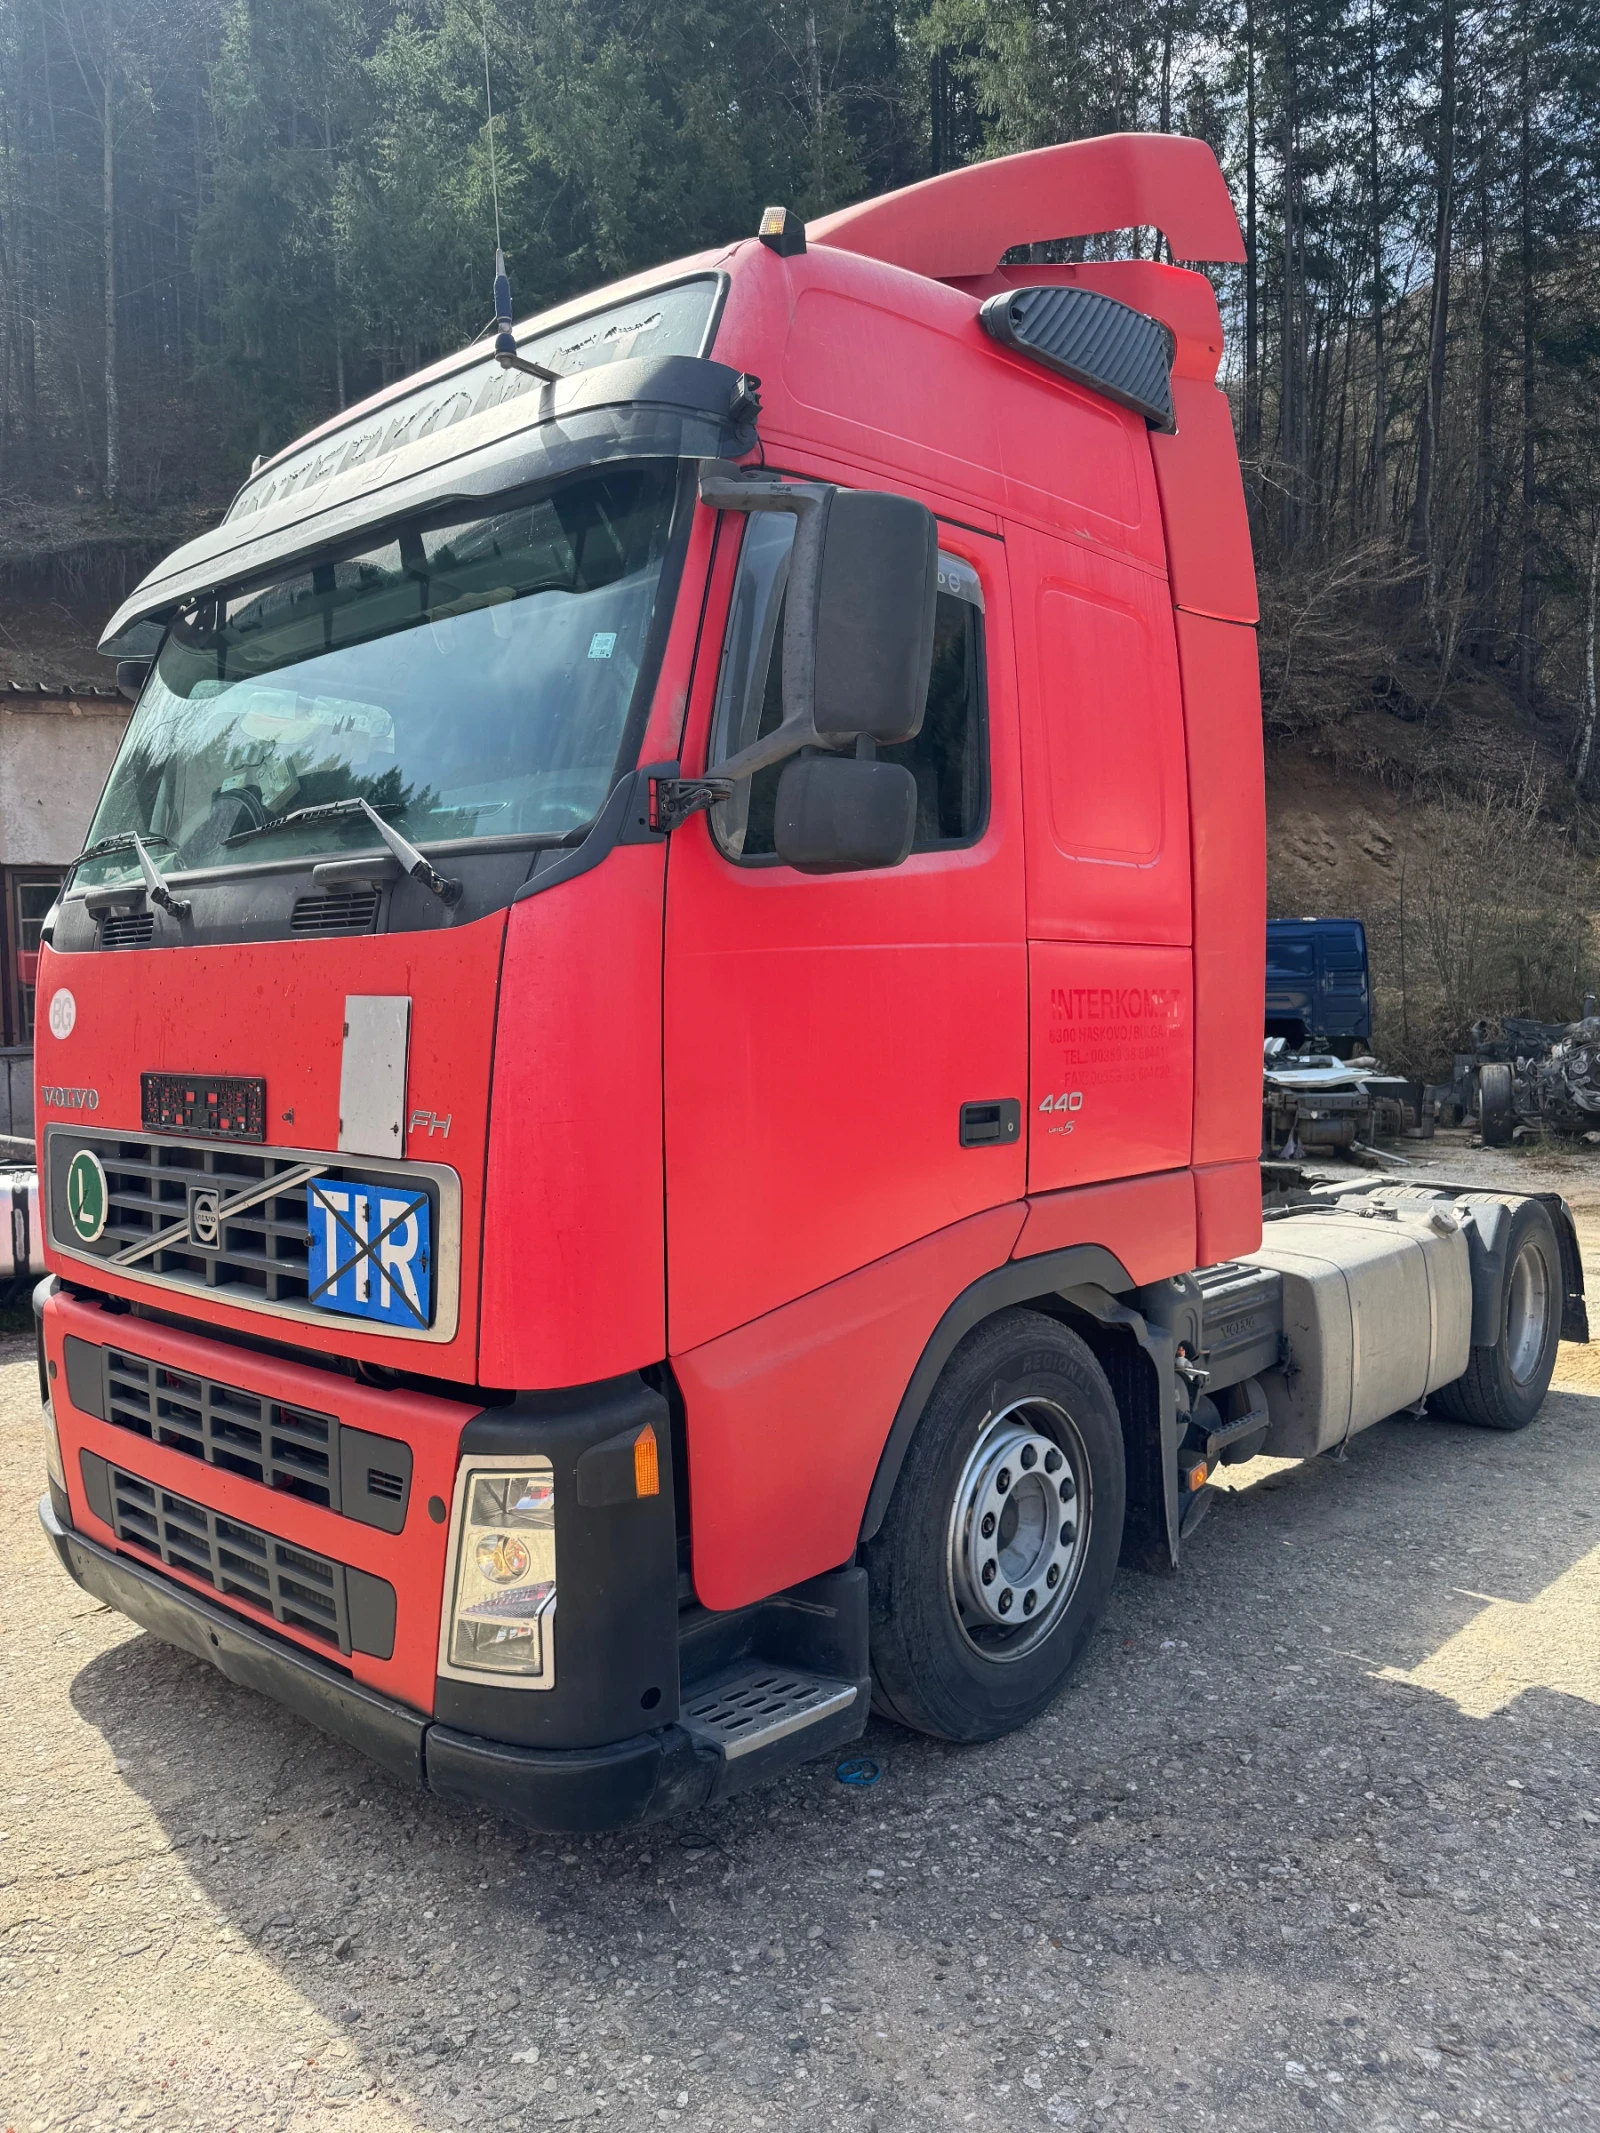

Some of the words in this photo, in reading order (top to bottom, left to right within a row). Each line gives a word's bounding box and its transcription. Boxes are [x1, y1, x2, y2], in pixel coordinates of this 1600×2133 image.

[52, 997, 72, 1030] BG
[1051, 988, 1181, 1020] INTERKOMET
[1049, 1027, 1075, 1044] 6300
[41, 1086, 99, 1110] VOLVO
[1038, 1091, 1083, 1113] 440
[408, 1110, 452, 1138] FH
[76, 1168, 94, 1224] L
[313, 1189, 422, 1316] TIR
[1220, 1315, 1256, 1338] VOLVO
[1022, 1351, 1092, 1396] REGIONAL
